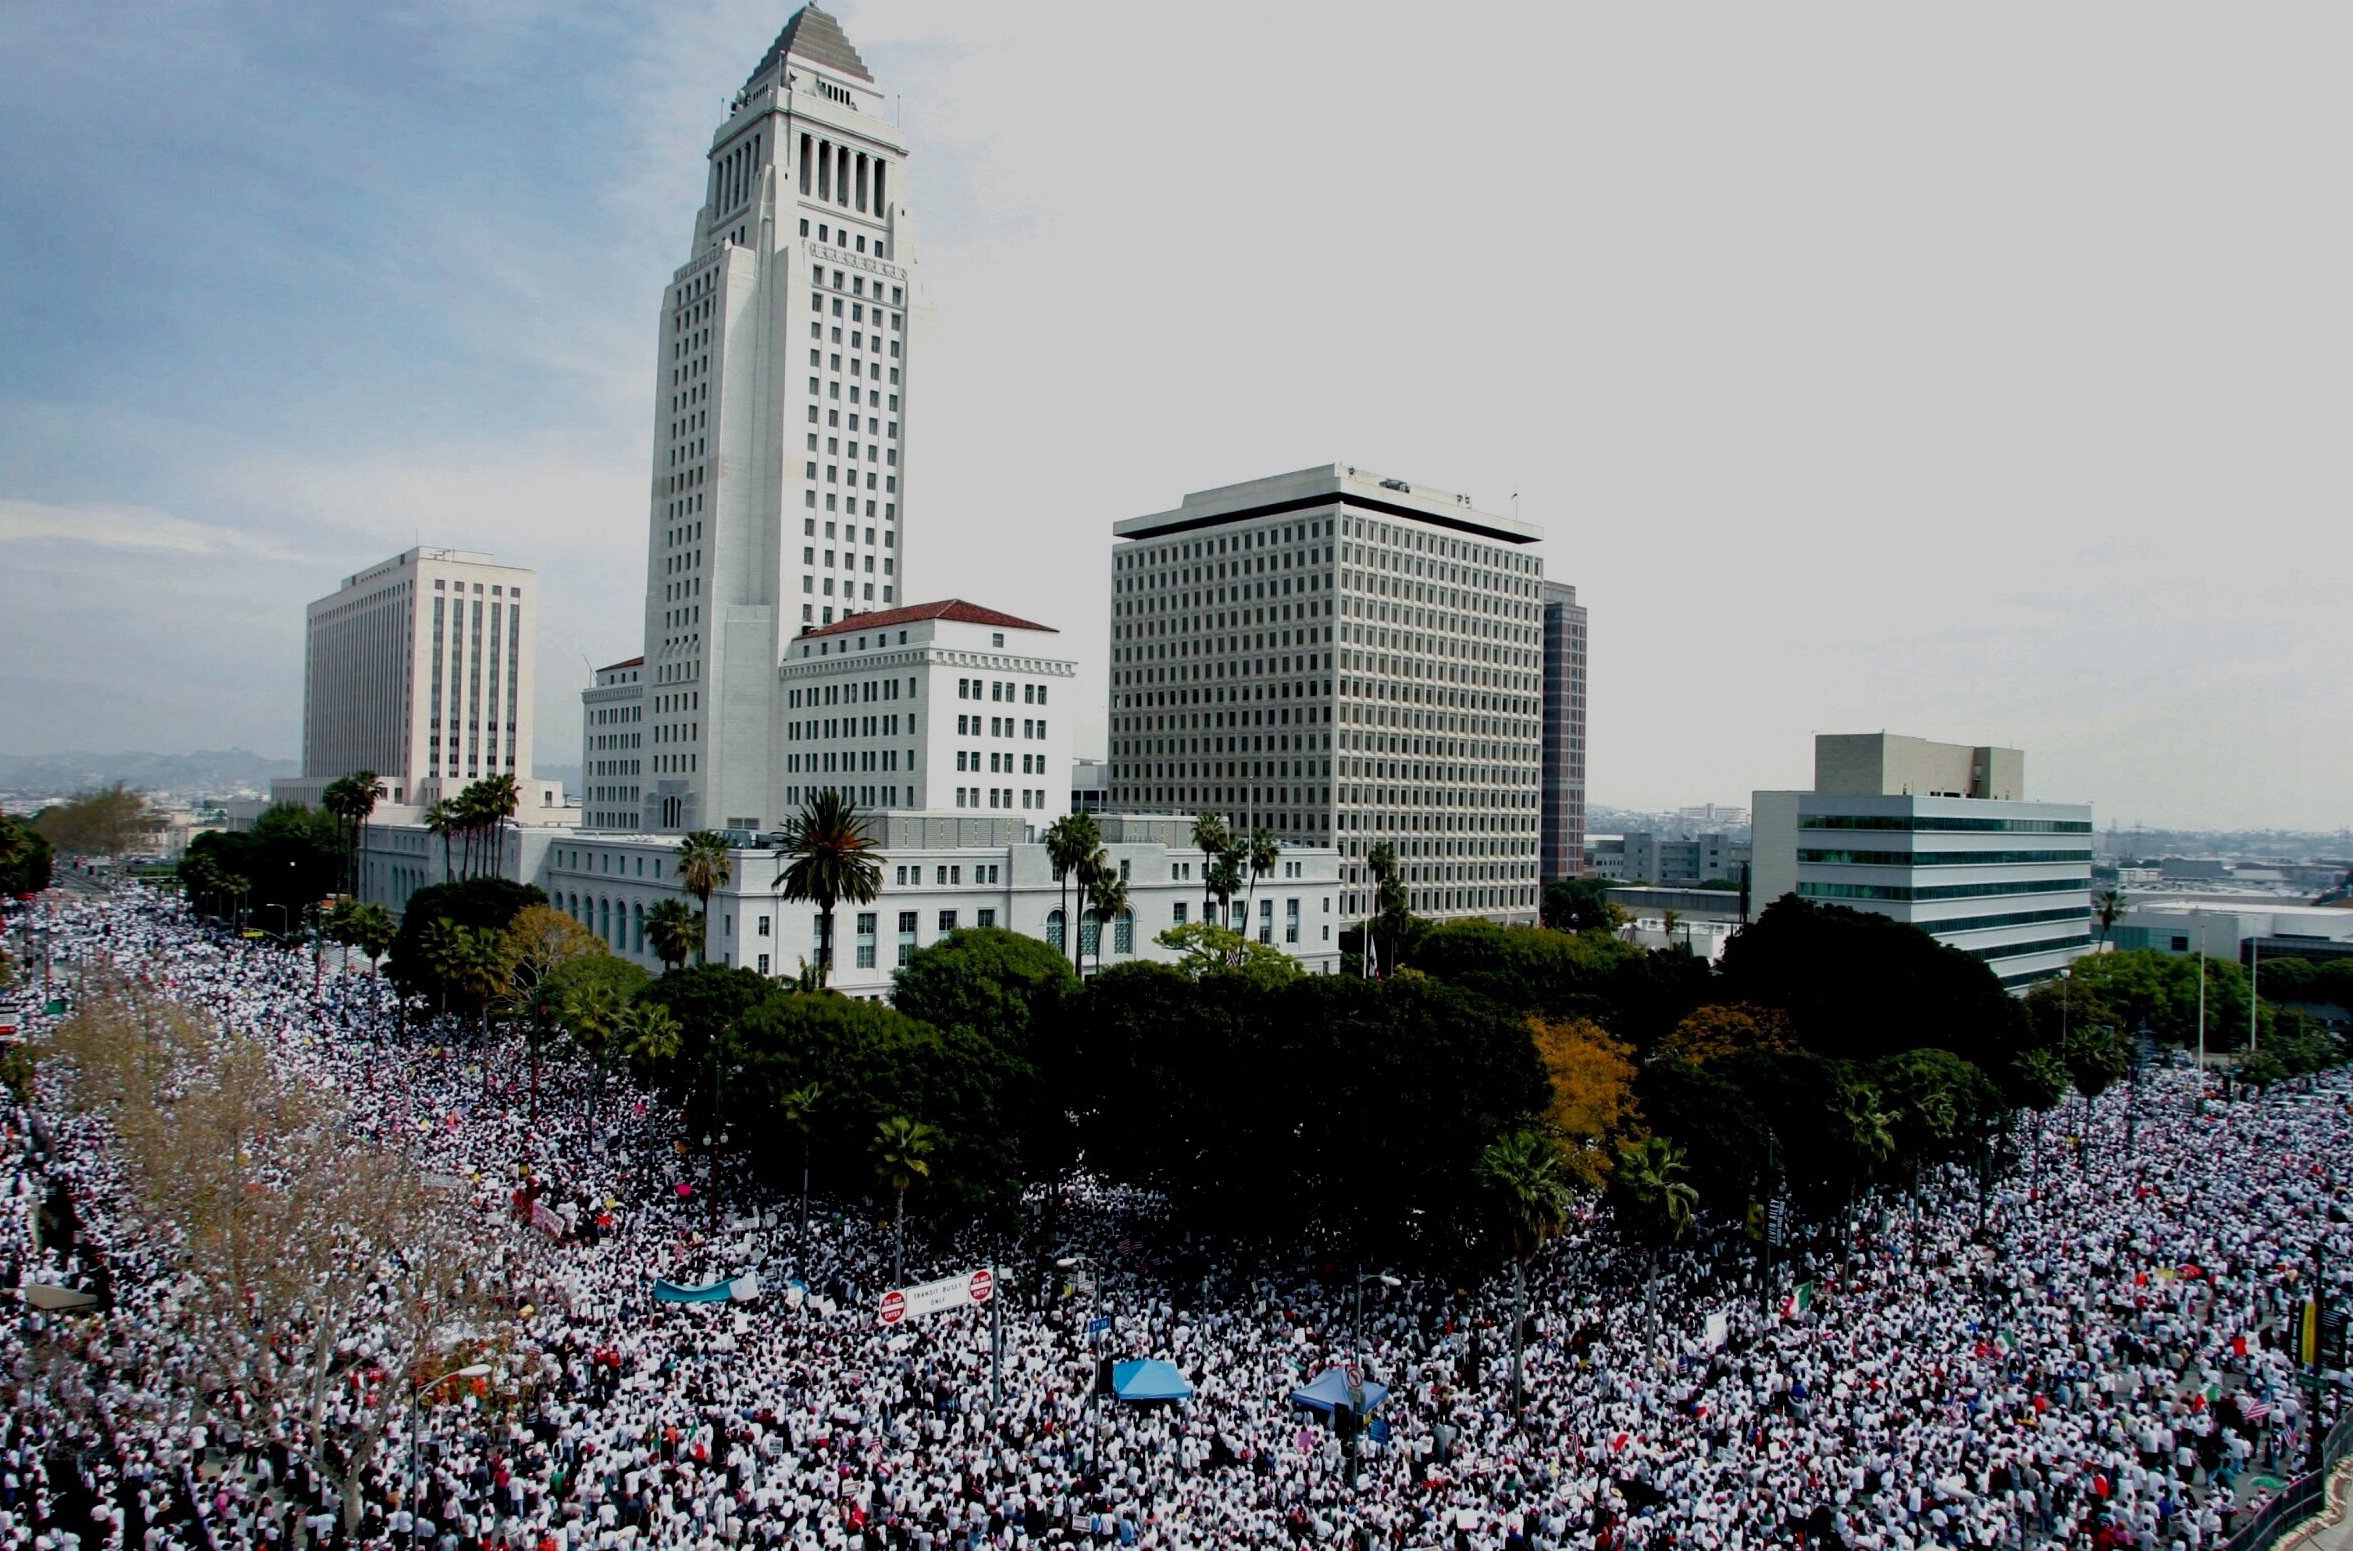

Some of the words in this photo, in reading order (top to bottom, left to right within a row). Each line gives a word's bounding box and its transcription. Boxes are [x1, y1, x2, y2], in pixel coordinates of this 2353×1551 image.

[1768, 1199, 1779, 1221] AILEY
[1768, 1222, 1777, 1244] ALVIN
[913, 1289, 938, 1300] TRANSIT
[942, 1282, 962, 1293] BUSES
[973, 1288, 989, 1297] ENTER
[892, 1296, 902, 1304] NOT
[930, 1297, 945, 1306] ONLY
[884, 1310, 901, 1319] ENTER
